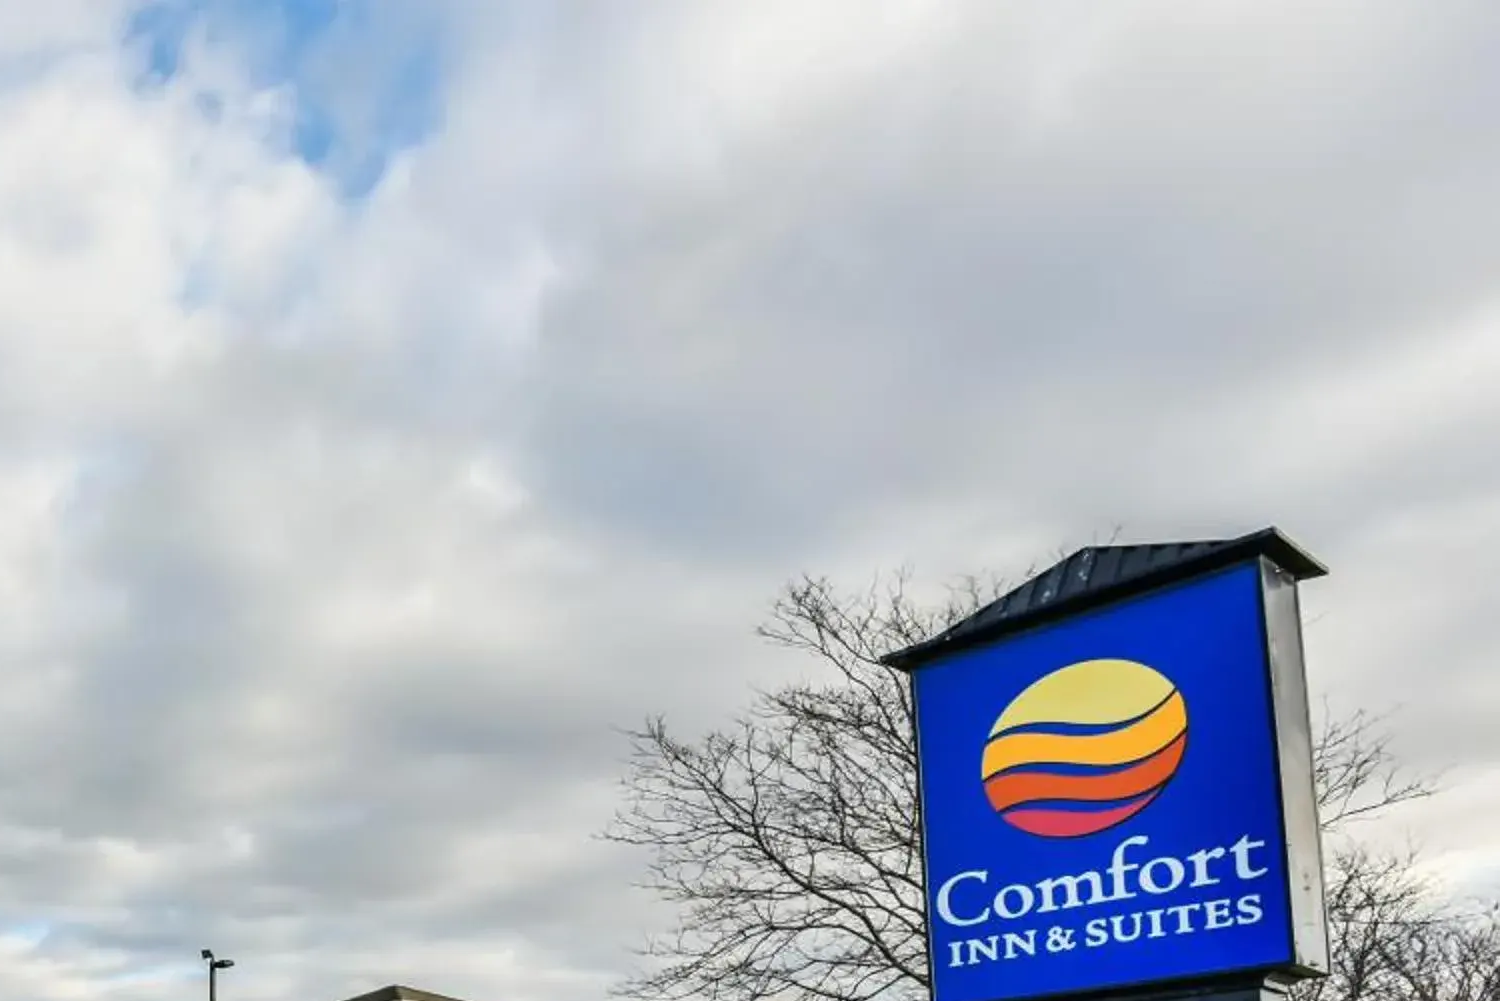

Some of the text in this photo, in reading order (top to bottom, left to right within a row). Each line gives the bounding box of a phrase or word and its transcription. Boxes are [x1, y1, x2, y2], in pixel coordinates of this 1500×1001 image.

[937, 834, 1268, 926] Comfort
[948, 894, 1263, 967] INN & SUITES
